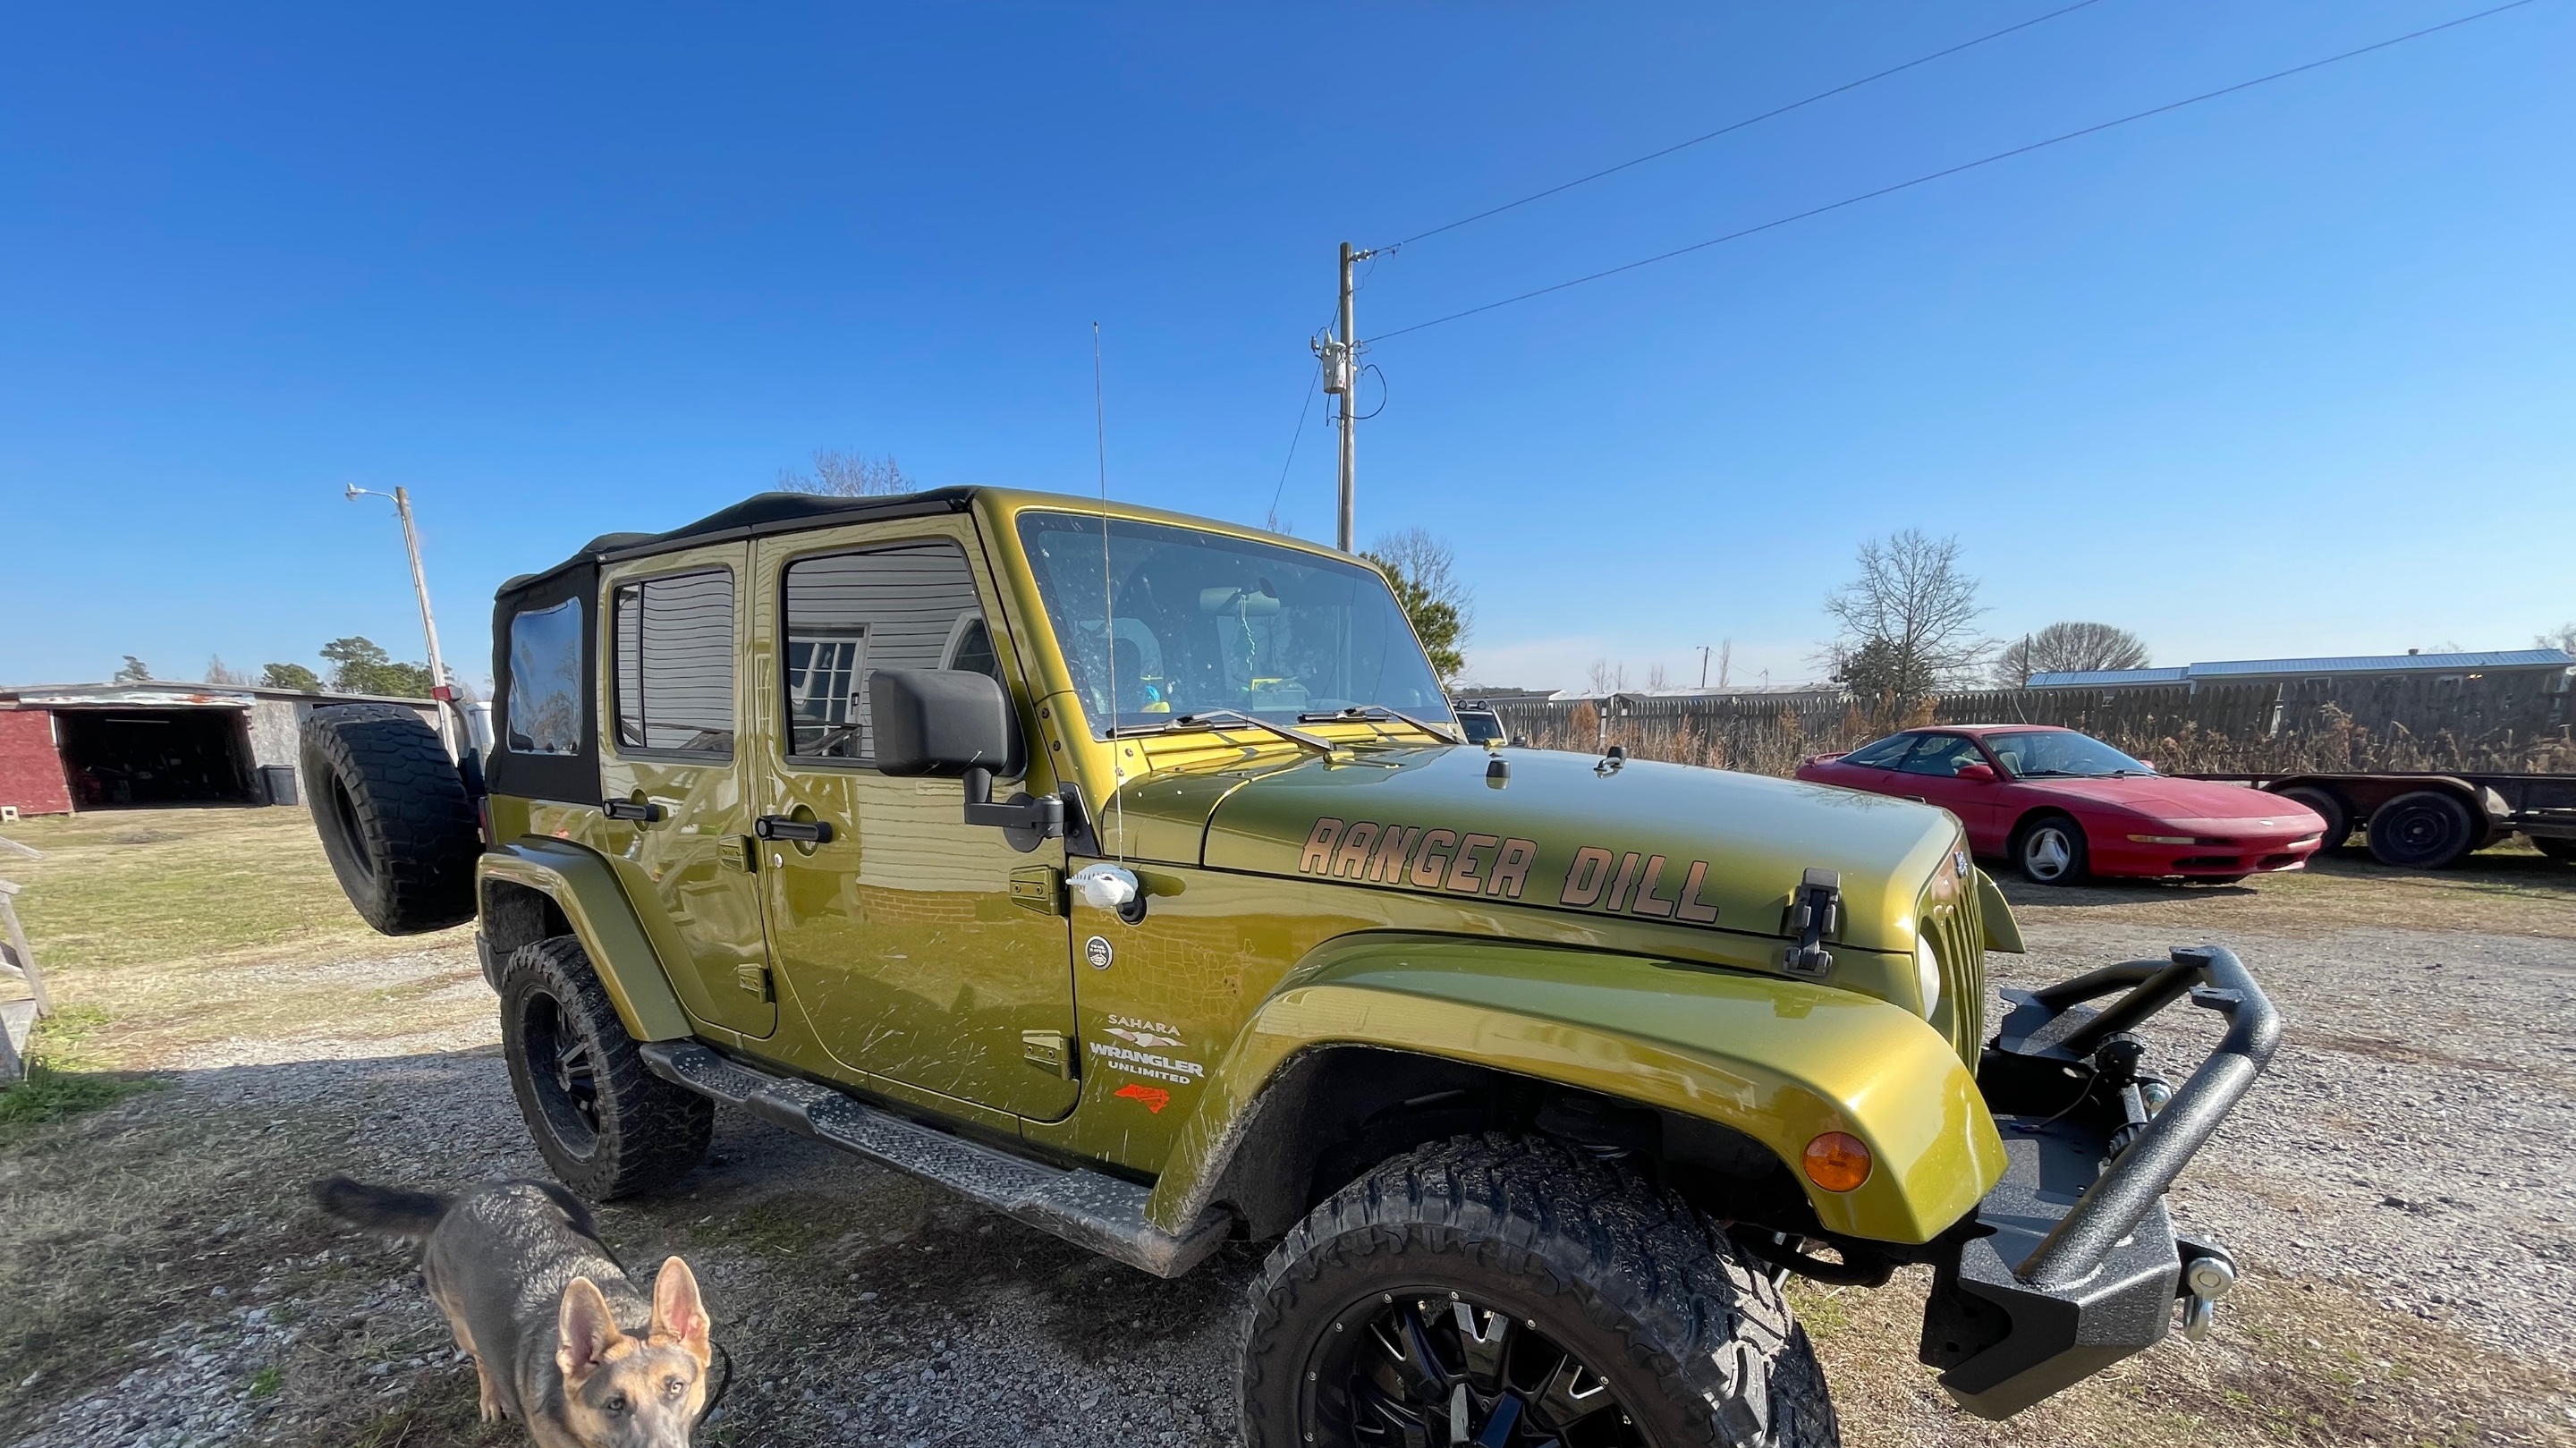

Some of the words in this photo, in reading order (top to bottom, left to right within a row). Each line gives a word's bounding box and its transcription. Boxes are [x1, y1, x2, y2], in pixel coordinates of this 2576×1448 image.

[1299, 817, 1538, 899] RANGER
[1559, 845, 1719, 924] DILL
[1107, 1013, 1181, 1037] SAHARA
[1089, 1042, 1205, 1078] WRANGLER
[1107, 1060, 1191, 1085] UNLIMITED
